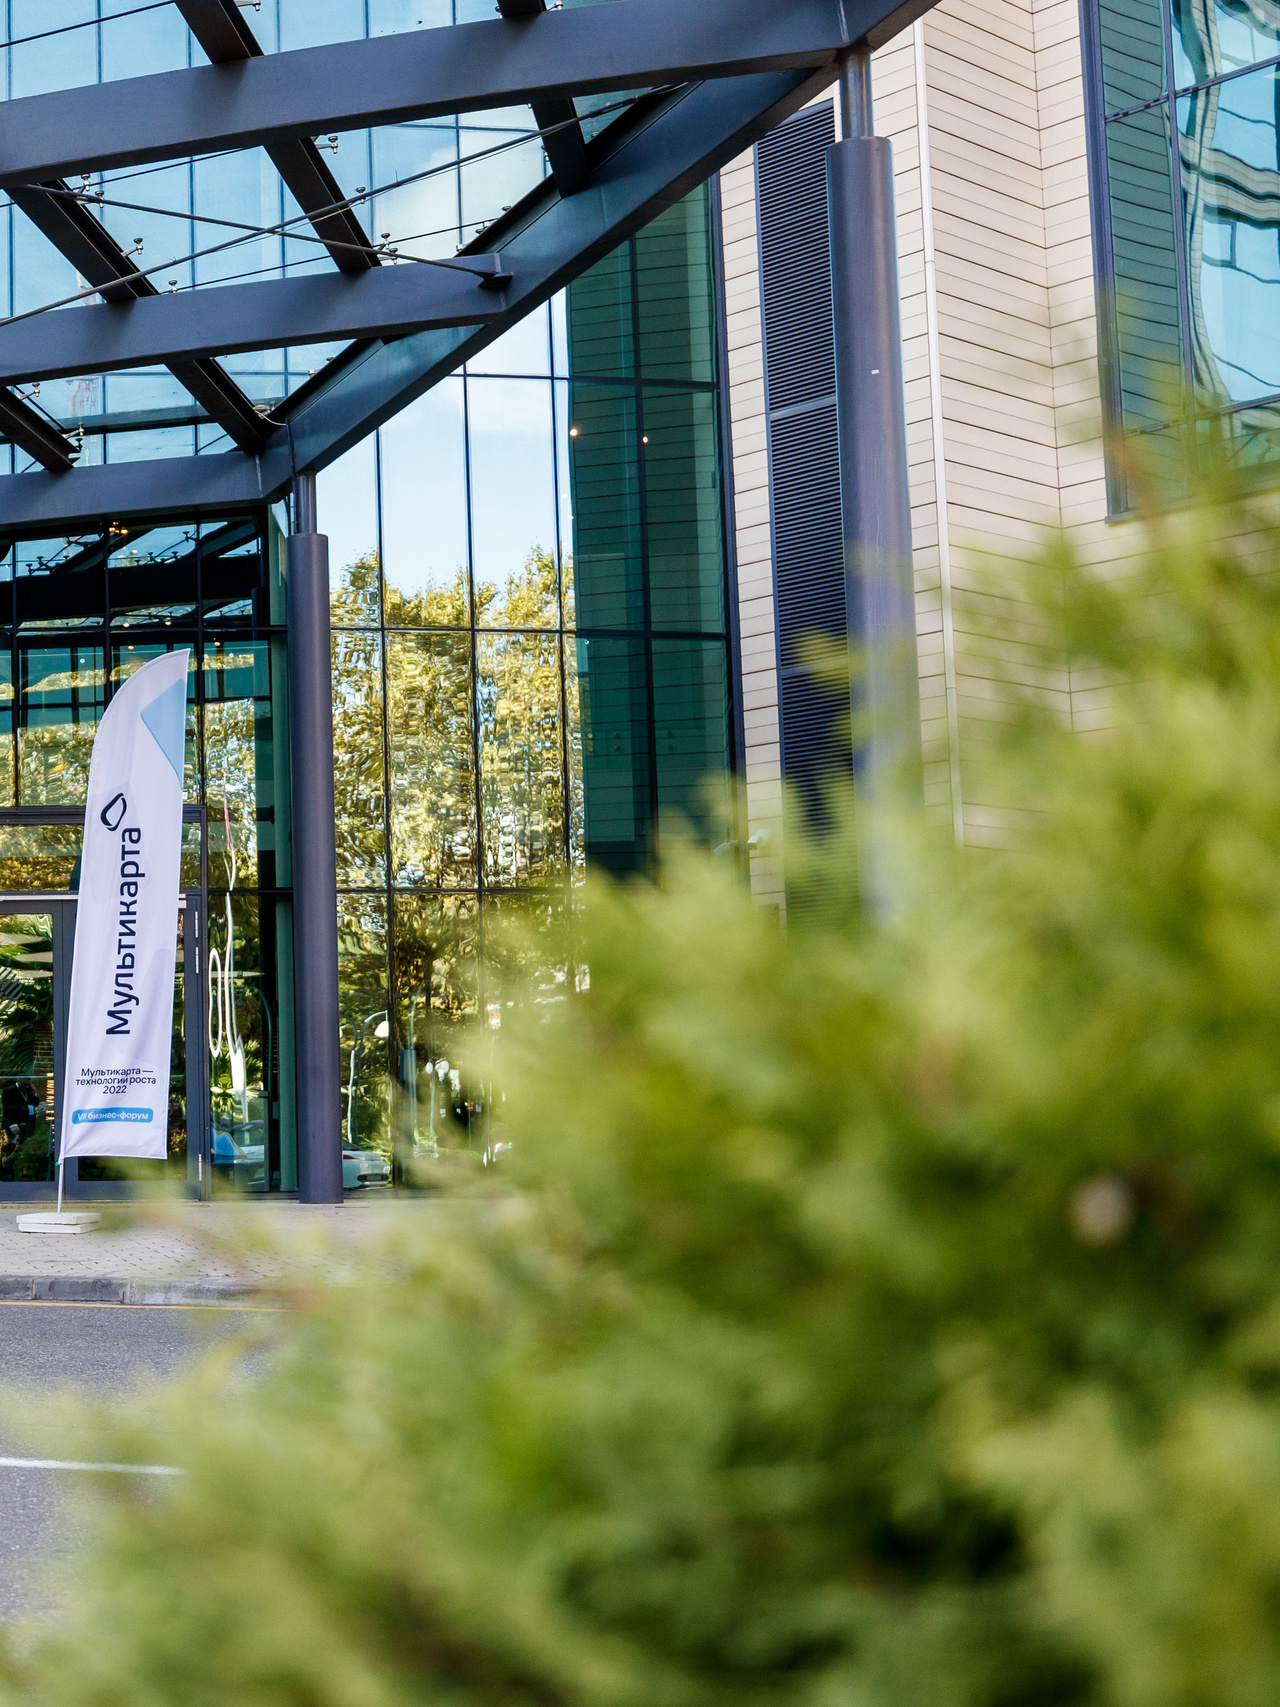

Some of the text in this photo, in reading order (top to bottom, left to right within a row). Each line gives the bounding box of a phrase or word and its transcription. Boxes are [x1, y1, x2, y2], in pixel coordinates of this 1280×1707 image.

[105, 827, 146, 1035] Мультикарта
[81, 1067, 141, 1078] Мультикарта
[75, 1076, 157, 1086] технологии роста
[102, 1085, 127, 1094] 2022
[87, 1111, 149, 1121] бизнес-форум
